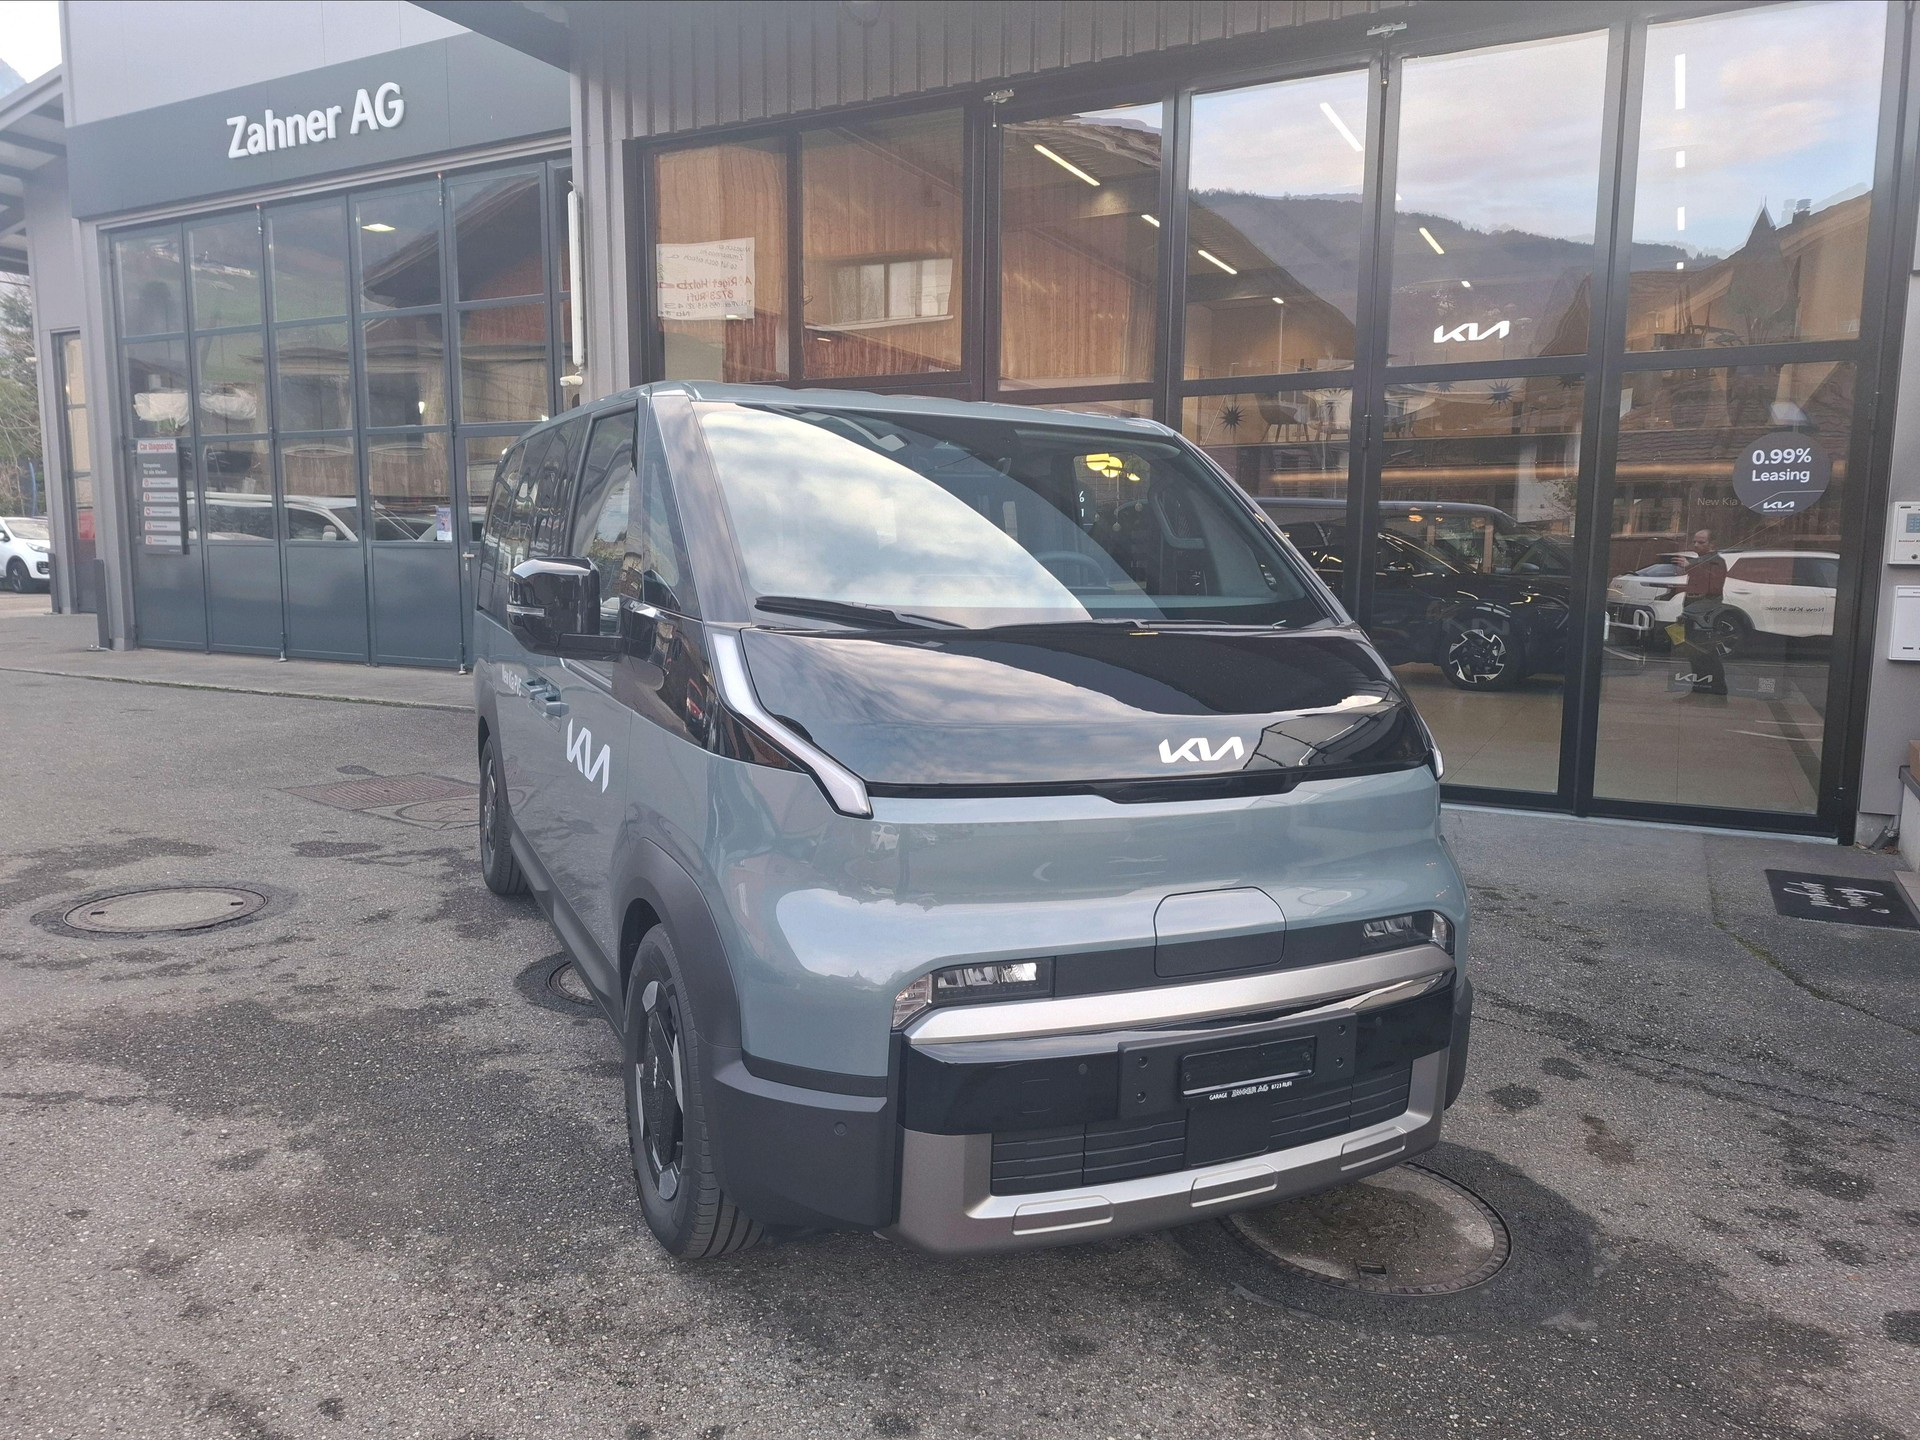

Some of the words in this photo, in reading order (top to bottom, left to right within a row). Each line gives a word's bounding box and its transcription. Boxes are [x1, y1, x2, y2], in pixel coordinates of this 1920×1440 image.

[226, 105, 342, 159] Zahner
[350, 81, 405, 135] AG
[1433, 320, 1510, 343] KIA
[148, 441, 174, 452] Diagnostic
[1751, 447, 1812, 465] 0.99%
[1751, 468, 1811, 483] Leasing
[1697, 497, 1720, 506] New
[1722, 497, 1738, 506] Kia
[1763, 501, 1795, 509] KIA
[1674, 672, 1713, 683] KIA
[566, 718, 611, 794] KIA
[1158, 736, 1245, 763] KIA
[1208, 1092, 1228, 1101] GARAGE
[1270, 1082, 1282, 1090] 8723
